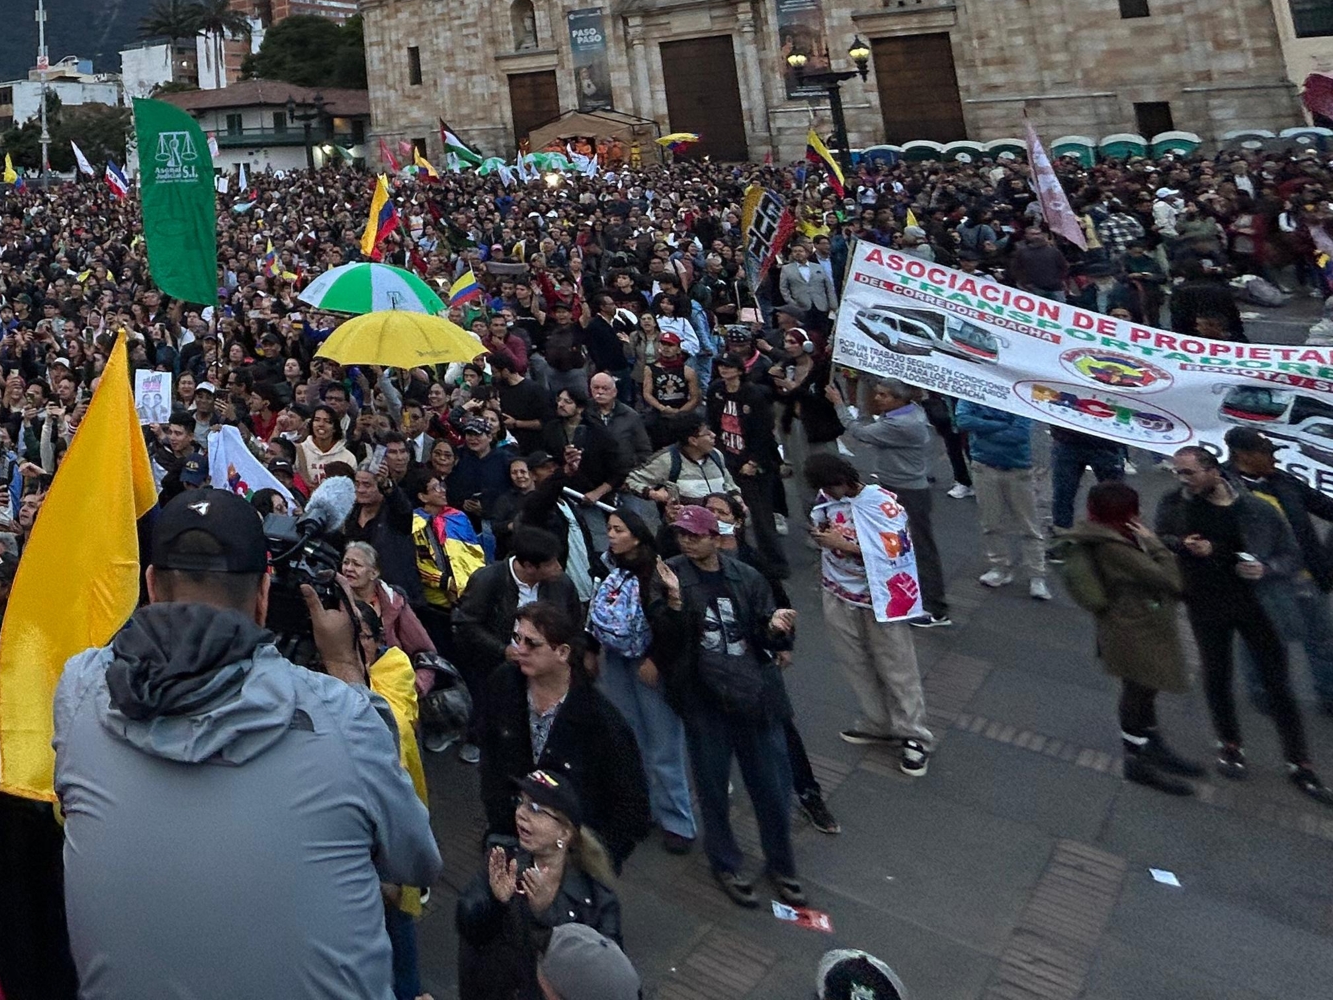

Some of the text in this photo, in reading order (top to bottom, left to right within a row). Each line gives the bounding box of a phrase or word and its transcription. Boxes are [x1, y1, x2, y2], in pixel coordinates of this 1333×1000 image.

[572, 28, 596, 37] PASO
[577, 34, 602, 44] PASO
[858, 274, 888, 290] DEL
[892, 283, 980, 319] CORREDOR
[984, 313, 1055, 342] SOACHA
[865, 248, 1061, 321] ASOCIACION
[1072, 311, 1118, 337] DE
[839, 338, 1011, 394] POR UN TRABAJO SEGURO EN CONDICIONES
[840, 346, 869, 360] DIGNAS
[876, 356, 905, 371] JUSTAS
[906, 364, 928, 377] PARA
[930, 372, 945, 381] LOS
[947, 376, 1008, 400] PROPIETARIOS
[858, 358, 986, 401] TRANSPORTADORES DE SOACHA
